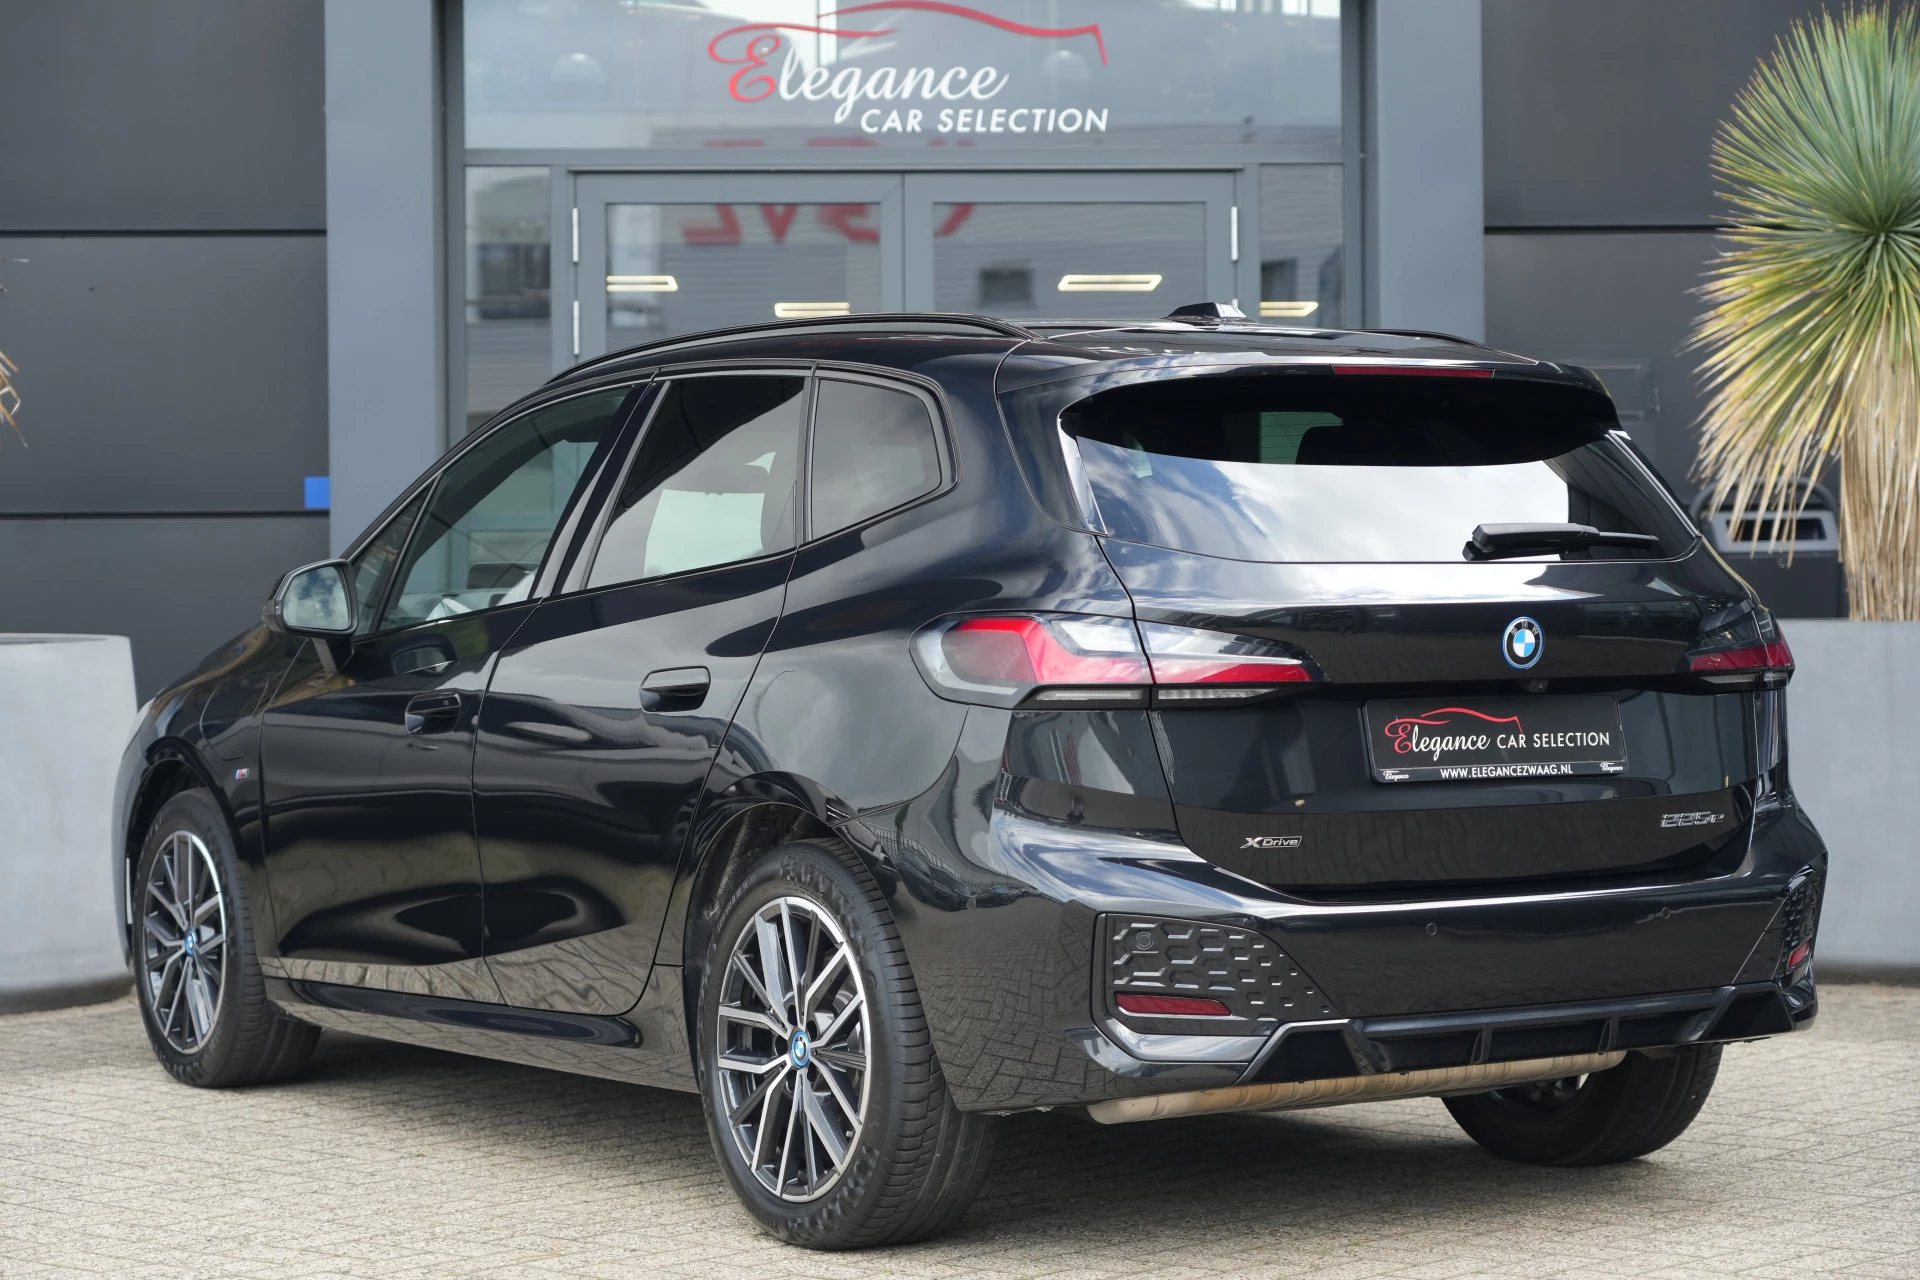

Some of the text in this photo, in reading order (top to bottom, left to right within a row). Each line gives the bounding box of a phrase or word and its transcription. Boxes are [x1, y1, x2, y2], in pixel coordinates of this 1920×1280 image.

[709, 25, 1010, 124] Elegance
[860, 108, 1109, 134] CAR SELECTION
[1385, 718, 1610, 762] Elegance CAR SELECTION
[1440, 764, 1574, 779] WWW.ELEGANCEZWAAG.NL
